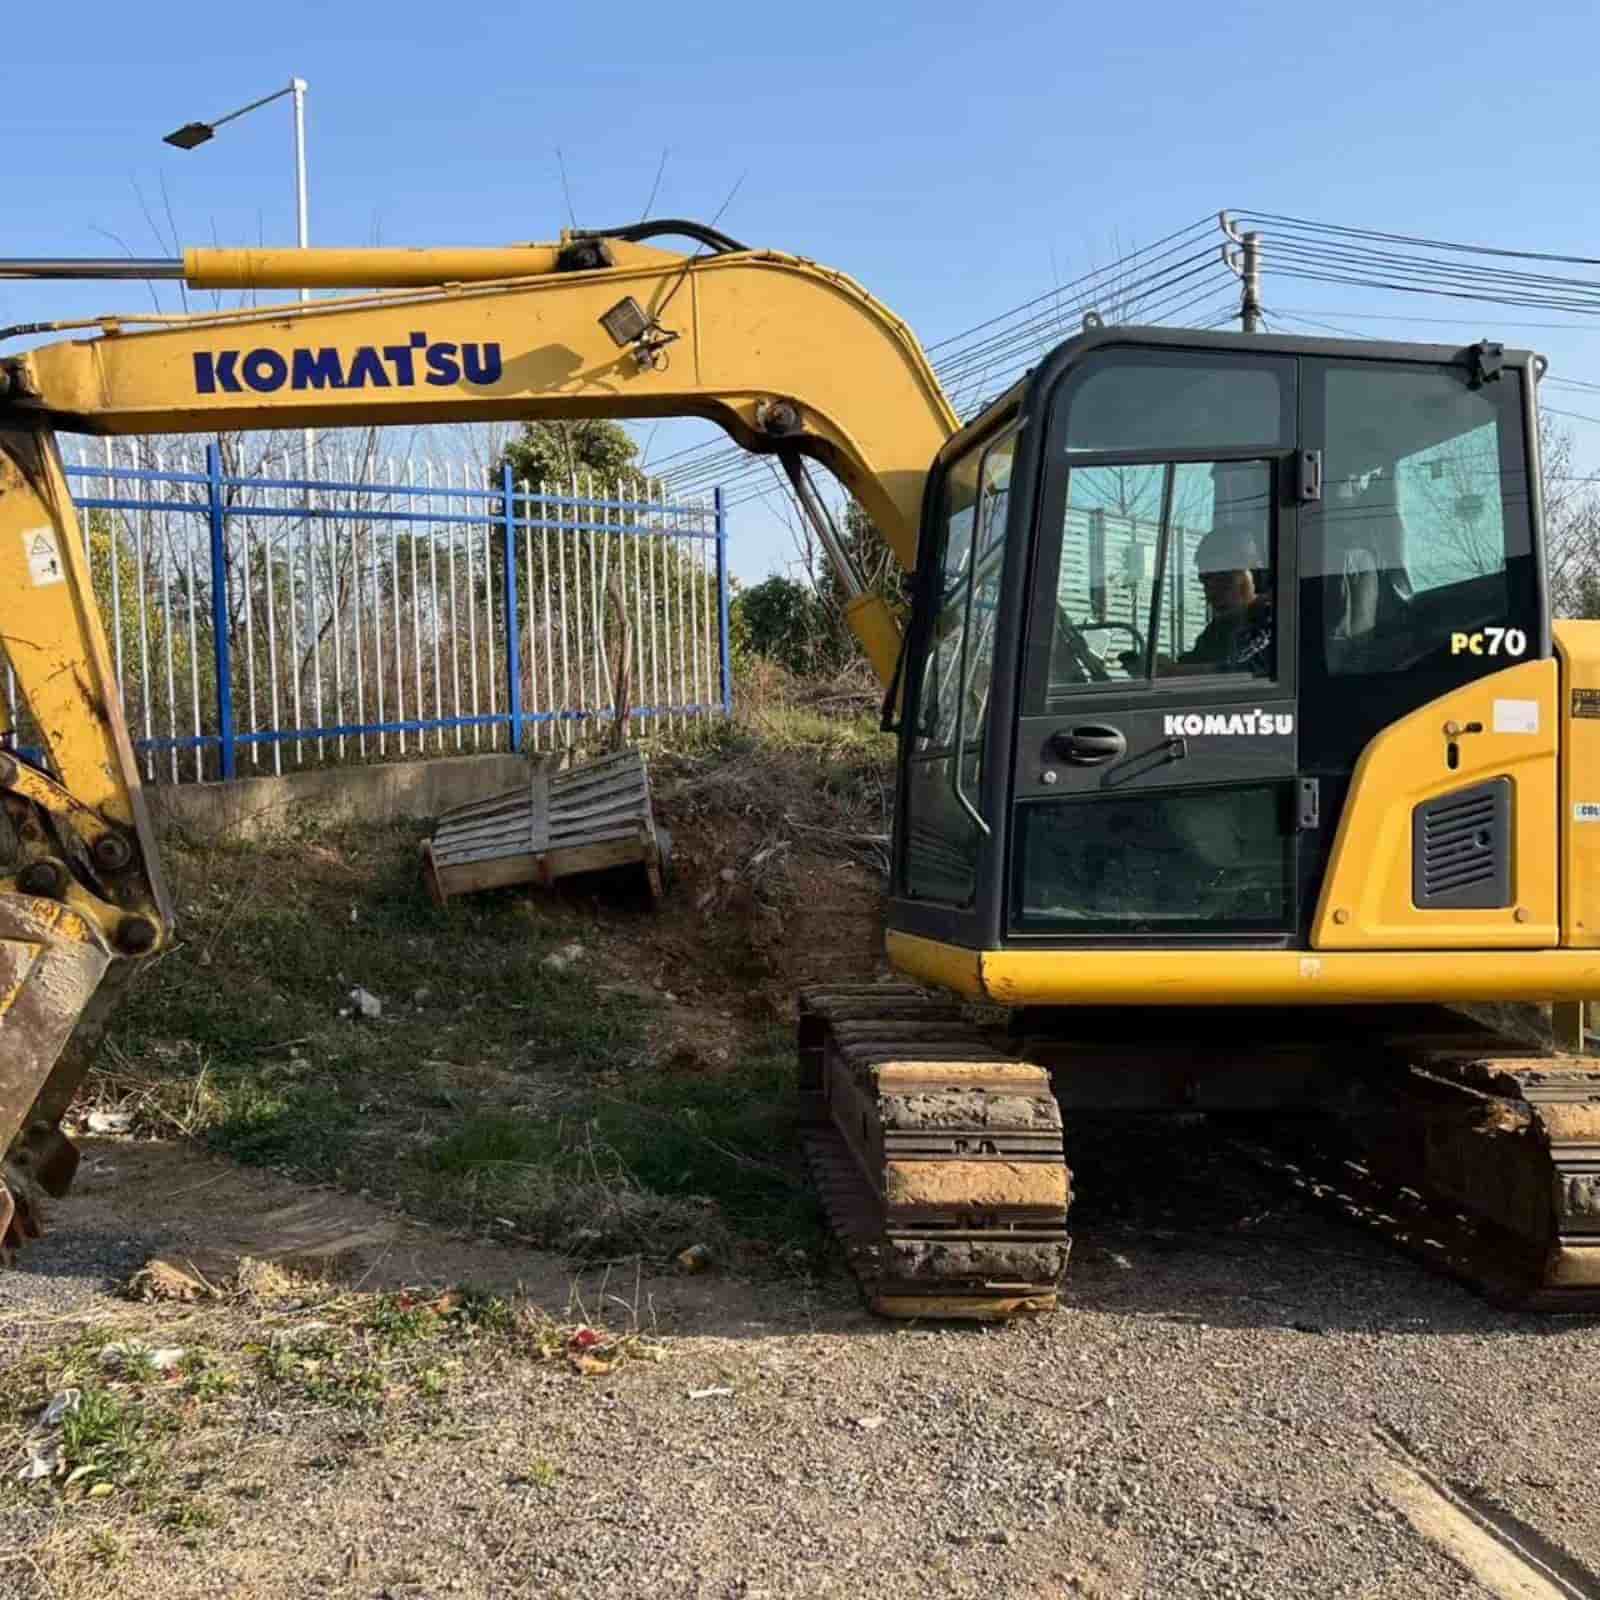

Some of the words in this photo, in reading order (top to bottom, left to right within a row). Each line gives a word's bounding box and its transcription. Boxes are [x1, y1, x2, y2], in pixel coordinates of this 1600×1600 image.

[194, 332, 502, 393] KOMATSU
[1451, 627, 1526, 655] PC70
[1164, 710, 1293, 735] KOMATSU
